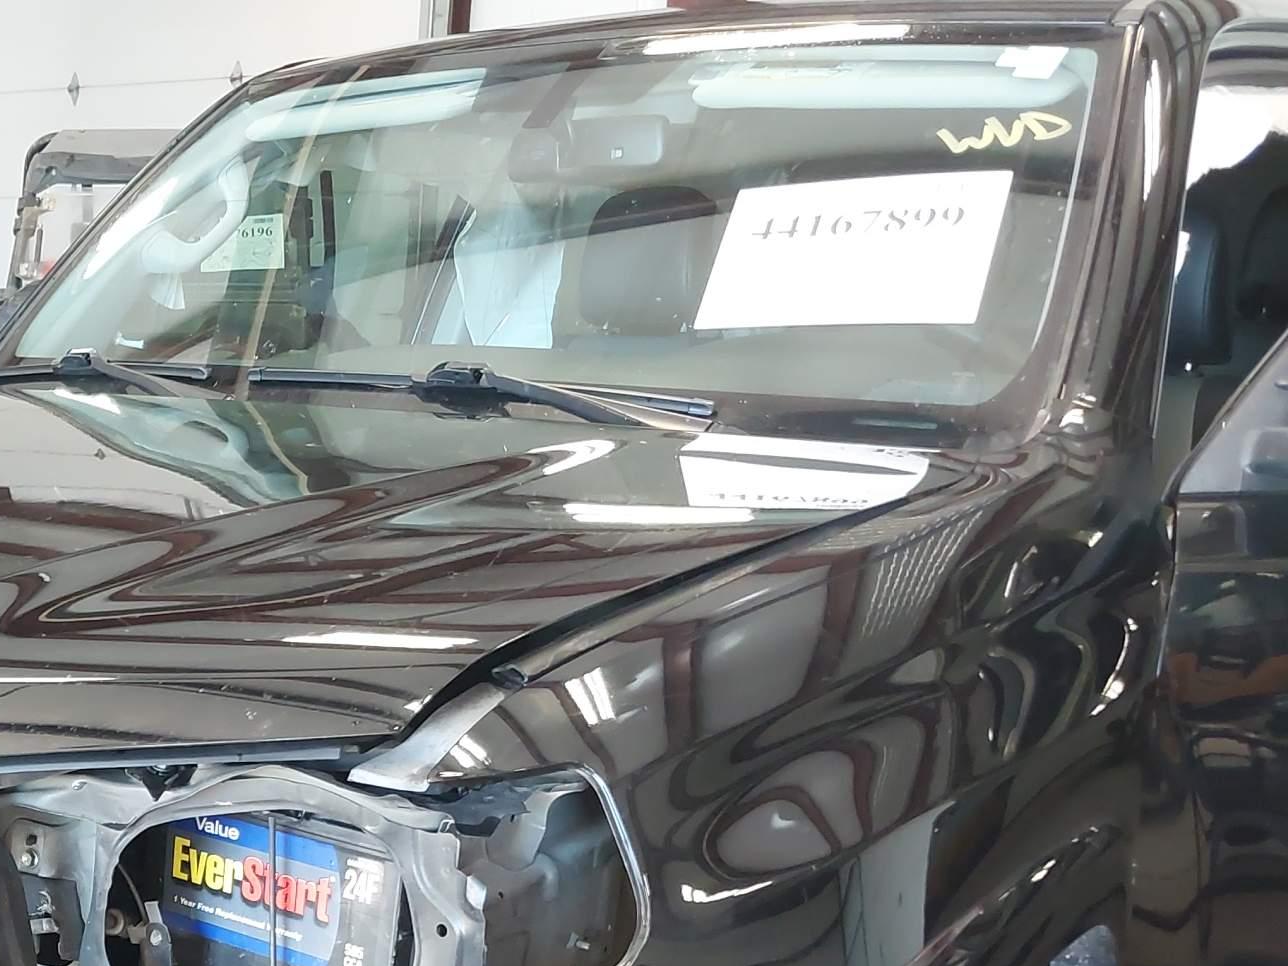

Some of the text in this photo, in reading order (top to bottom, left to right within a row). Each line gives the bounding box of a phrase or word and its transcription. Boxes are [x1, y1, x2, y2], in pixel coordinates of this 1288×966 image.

[237, 226, 273, 238] 6196
[195, 815, 240, 840] Value
[172, 836, 333, 924] EverStart
[180, 897, 196, 908] Year
[197, 902, 215, 915] Free
